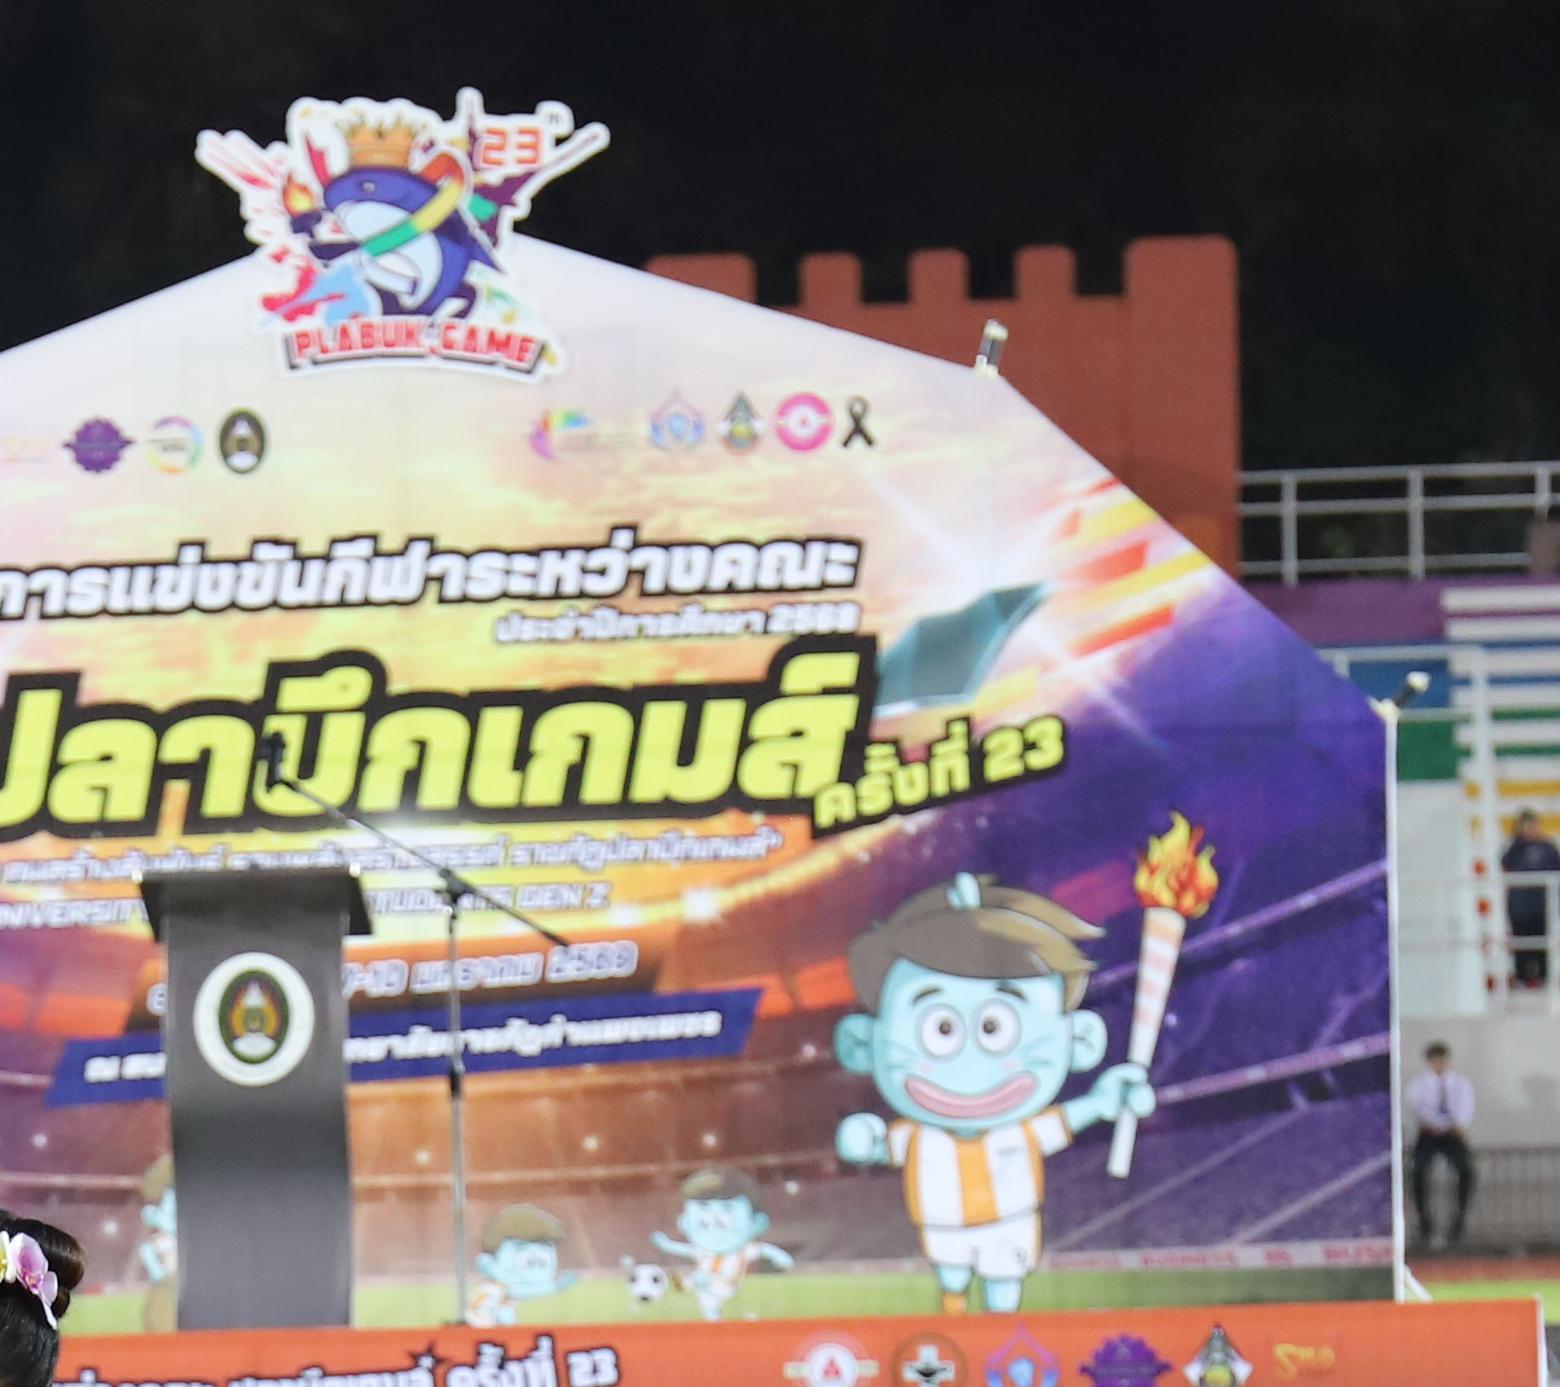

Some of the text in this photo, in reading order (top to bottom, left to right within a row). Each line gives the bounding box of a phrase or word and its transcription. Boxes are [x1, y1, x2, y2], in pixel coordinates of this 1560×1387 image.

[482, 127, 542, 166] 23
[293, 317, 544, 365] PLABUK GAME
[814, 718, 972, 827] ครั้งที่
[982, 715, 1066, 782] 23
